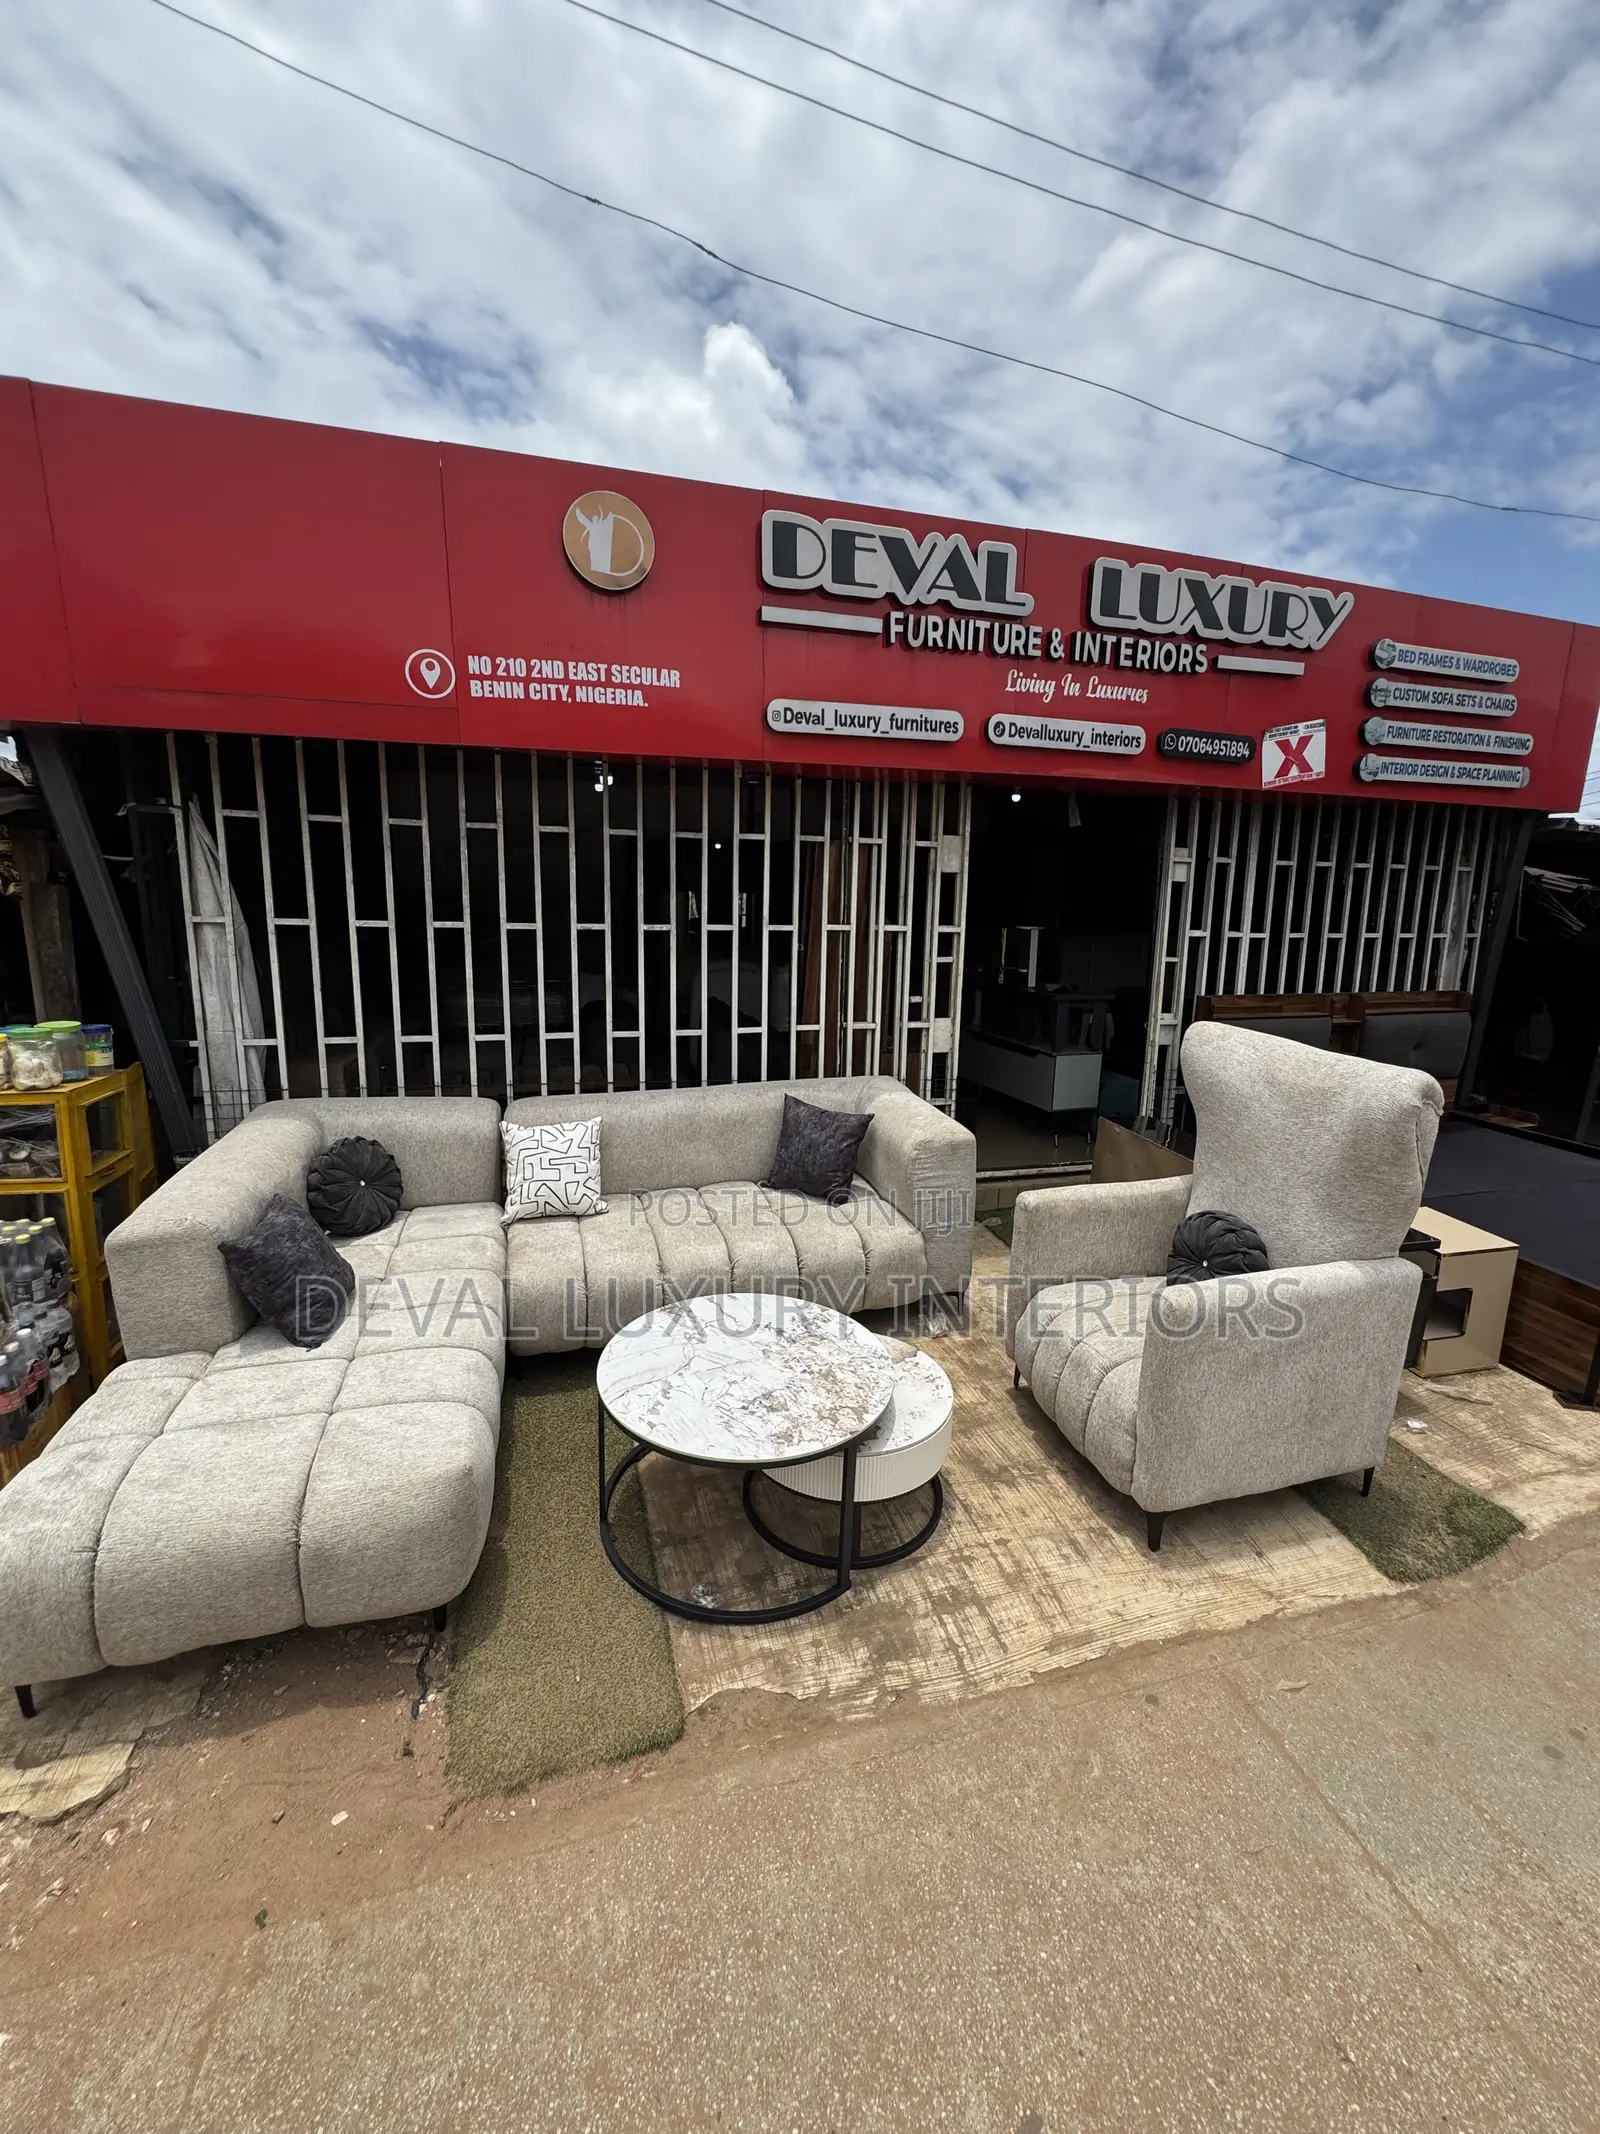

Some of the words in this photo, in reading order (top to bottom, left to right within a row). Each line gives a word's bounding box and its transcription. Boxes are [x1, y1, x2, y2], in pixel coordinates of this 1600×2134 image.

[770, 518, 1029, 608] DEVAL
[1098, 564, 1350, 645] LUXURY
[890, 611, 1043, 657] FURNITURE
[1050, 628, 1065, 659] &
[1075, 631, 1208, 673] INTERIORS
[467, 655, 492, 676] NO
[496, 657, 527, 677] 210
[530, 659, 565, 680] 2ND
[568, 661, 607, 682] EAST
[611, 664, 681, 688] SECULAR
[1398, 649, 1417, 664] BED
[1417, 652, 1454, 669] FRAMES
[1455, 658, 1461, 670] &
[1463, 658, 1518, 677] WARDROBES
[470, 680, 524, 699] BENIN
[529, 683, 572, 704] CITY,
[576, 685, 649, 707] NIGERIA.
[1005, 669, 1056, 703] Living
[1061, 673, 1081, 697] In
[1086, 675, 1150, 704] Luxuries
[1393, 687, 1431, 703] CUSTOM
[1432, 691, 1454, 706] SOFA
[1456, 693, 1477, 707] SETS
[1478, 698, 1484, 708] &
[1485, 696, 1516, 711] CHAIRS
[783, 707, 959, 734] Deval_luxury_furnitures
[1008, 722, 1142, 749] Devalluxury_interiors
[1178, 737, 1251, 758] 07064951894
[1386, 726, 1431, 742] FURNITURE
[1432, 730, 1485, 746] RESTORATION
[1486, 735, 1491, 747] &
[1493, 735, 1531, 750] FINISHING
[1380, 762, 1419, 775] INTERIOR
[1420, 764, 1449, 778] DESIGN
[1450, 766, 1456, 778] &
[1456, 766, 1482, 780] SPACE
[1482, 769, 1522, 782] PLANNING
